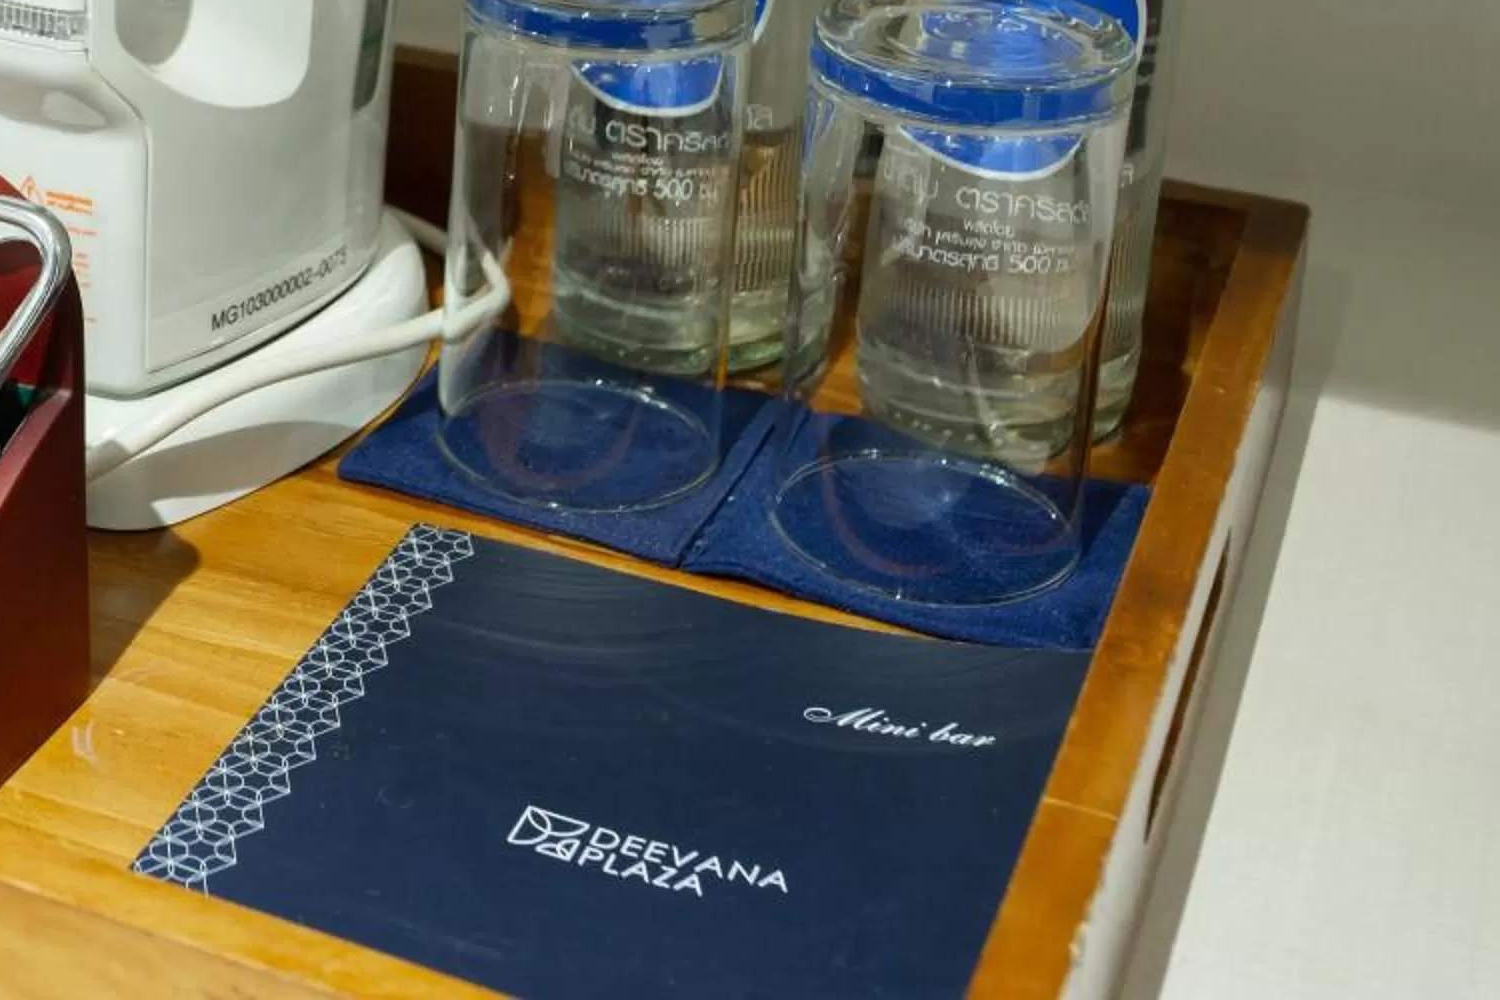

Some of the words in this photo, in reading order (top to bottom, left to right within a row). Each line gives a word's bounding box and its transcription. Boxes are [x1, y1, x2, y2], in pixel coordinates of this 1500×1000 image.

[652, 177, 695, 201] 500
[1007, 252, 1051, 275] 500
[803, 706, 927, 738] Mini
[929, 722, 997, 746] bar
[577, 846, 703, 897] PLAZA
[590, 827, 789, 893] DEEVANA
